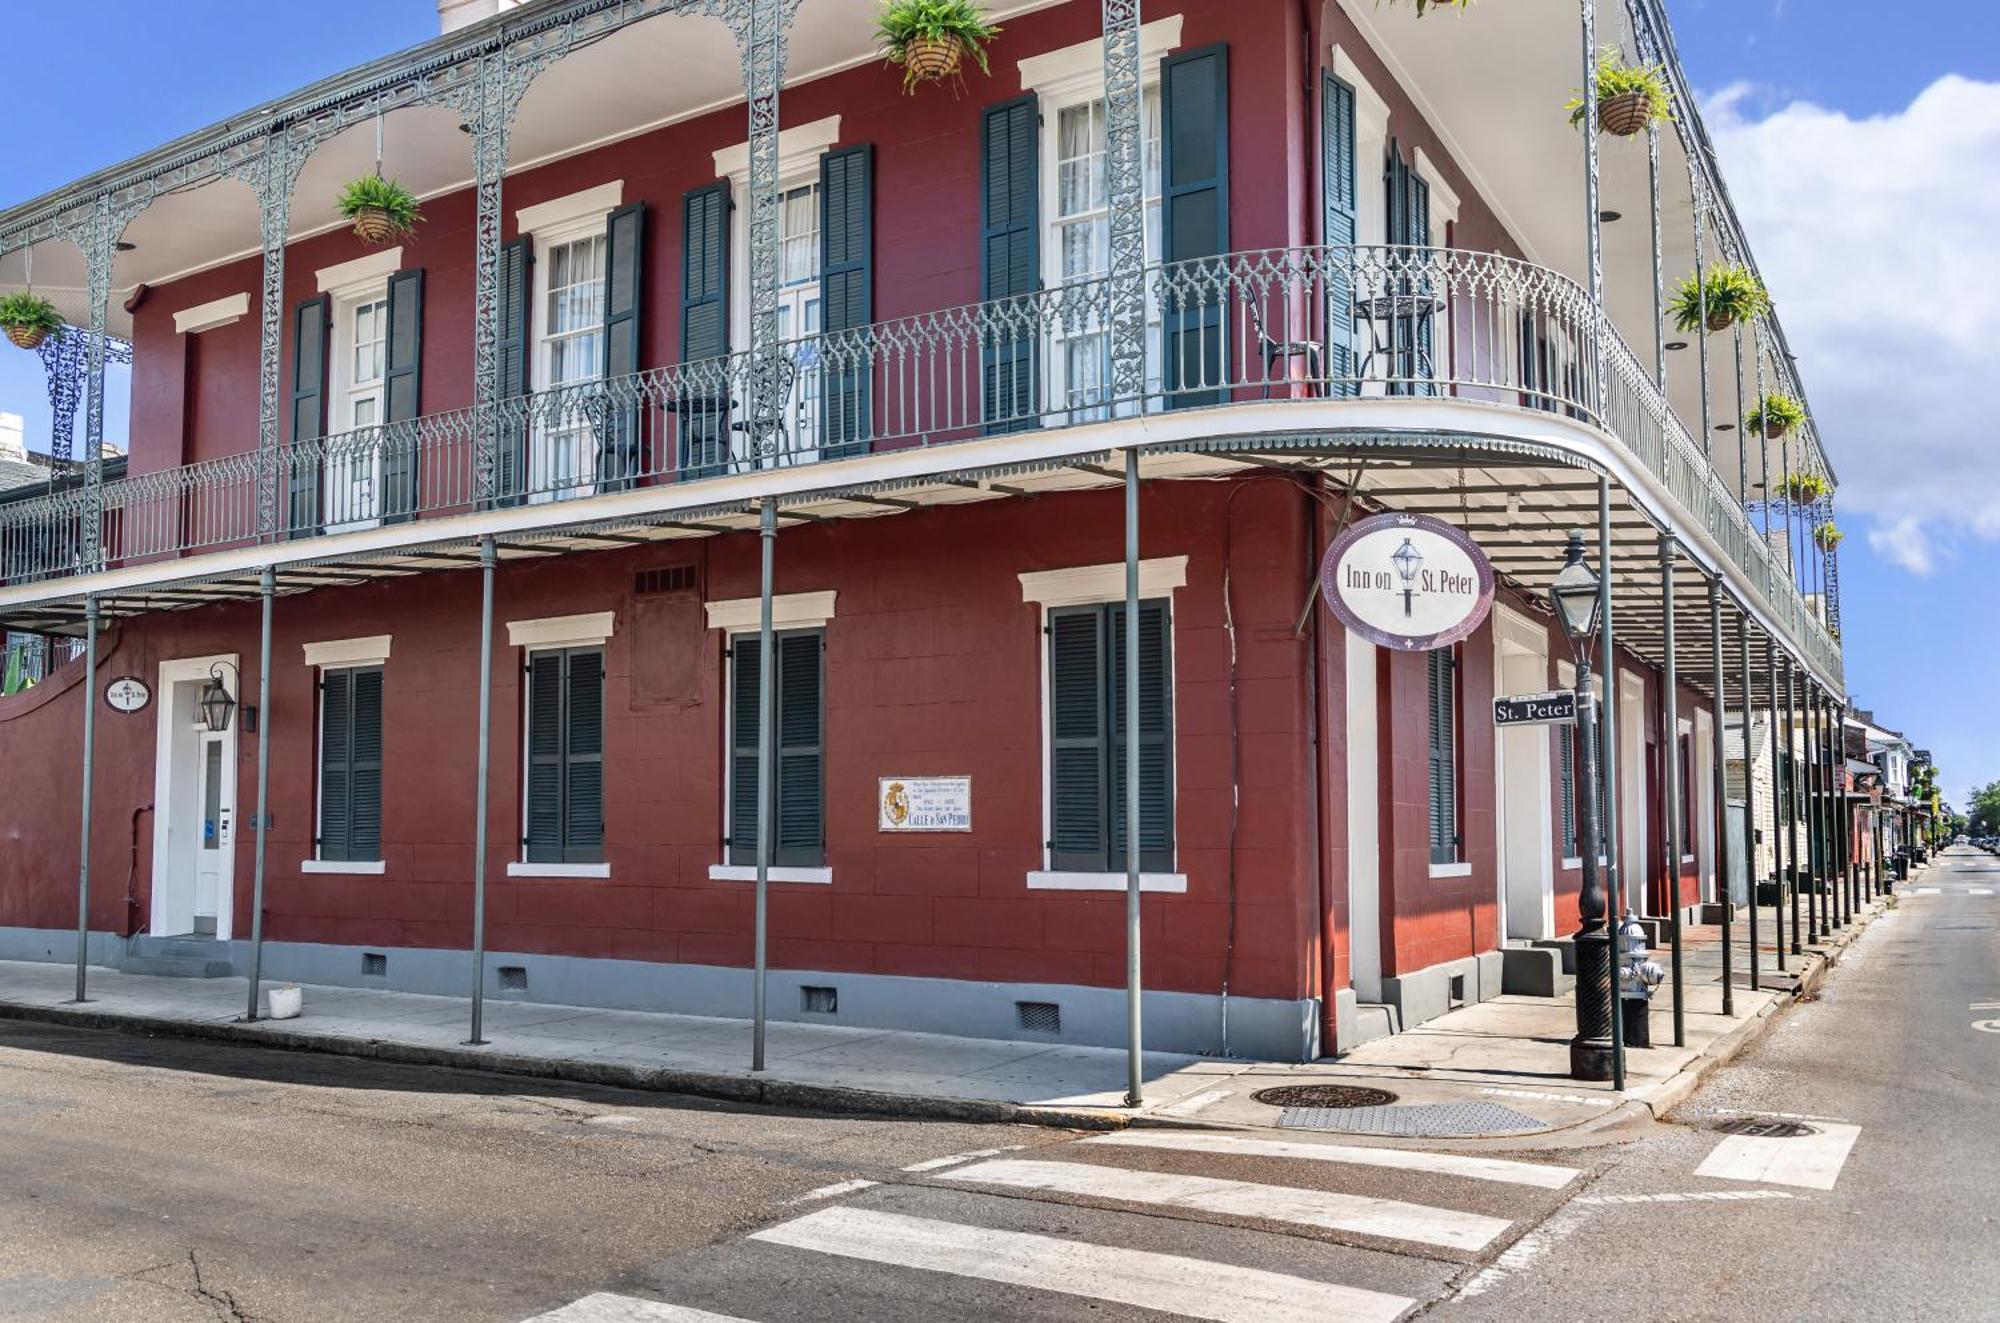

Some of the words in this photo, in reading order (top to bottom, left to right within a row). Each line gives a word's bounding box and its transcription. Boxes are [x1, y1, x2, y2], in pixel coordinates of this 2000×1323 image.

[1346, 564, 1371, 589] Inn
[1375, 571, 1392, 590] on
[1422, 569, 1437, 593] St.
[1440, 570, 1473, 595] Peter
[1497, 706, 1519, 721] St.
[1526, 703, 1572, 718] Peter
